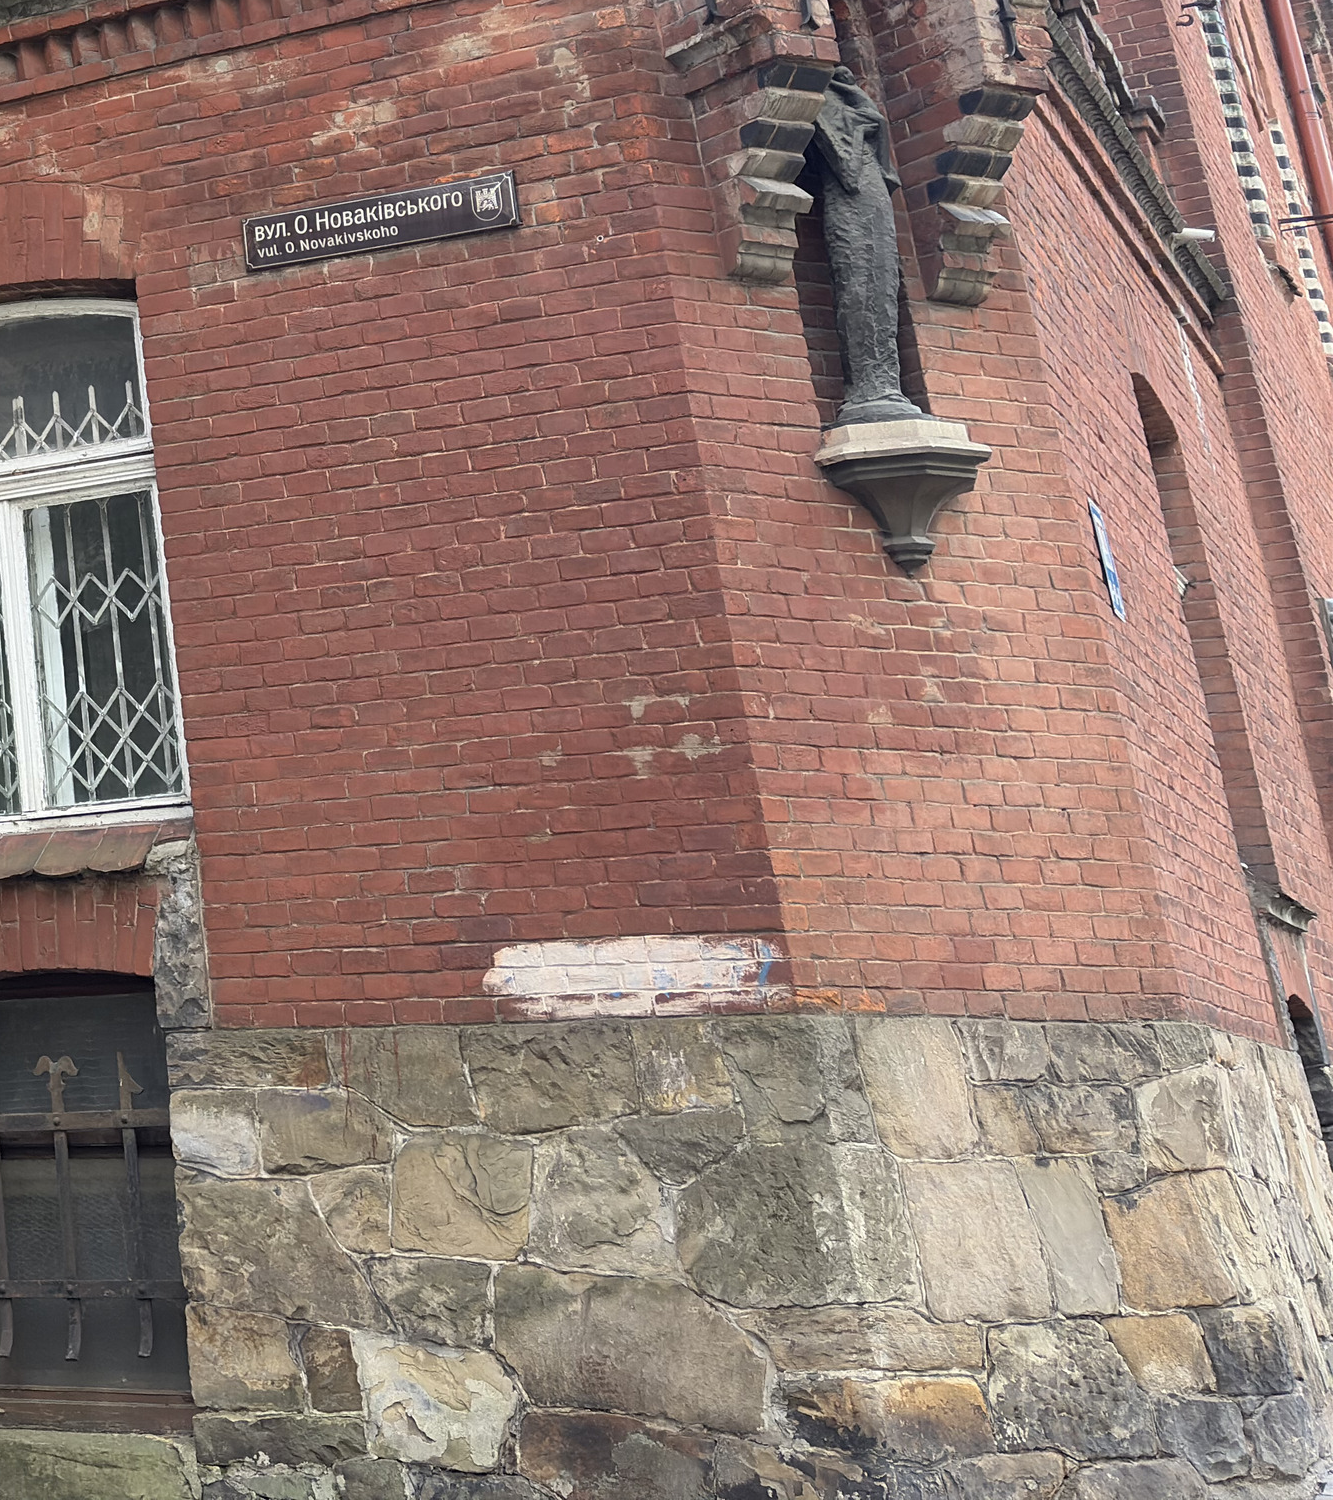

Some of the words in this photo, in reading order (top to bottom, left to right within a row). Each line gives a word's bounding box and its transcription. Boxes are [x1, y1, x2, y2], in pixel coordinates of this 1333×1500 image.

[315, 191, 463, 231] Новаківського
[257, 244, 282, 258] vul.
[299, 225, 399, 252] Novakivskoho
